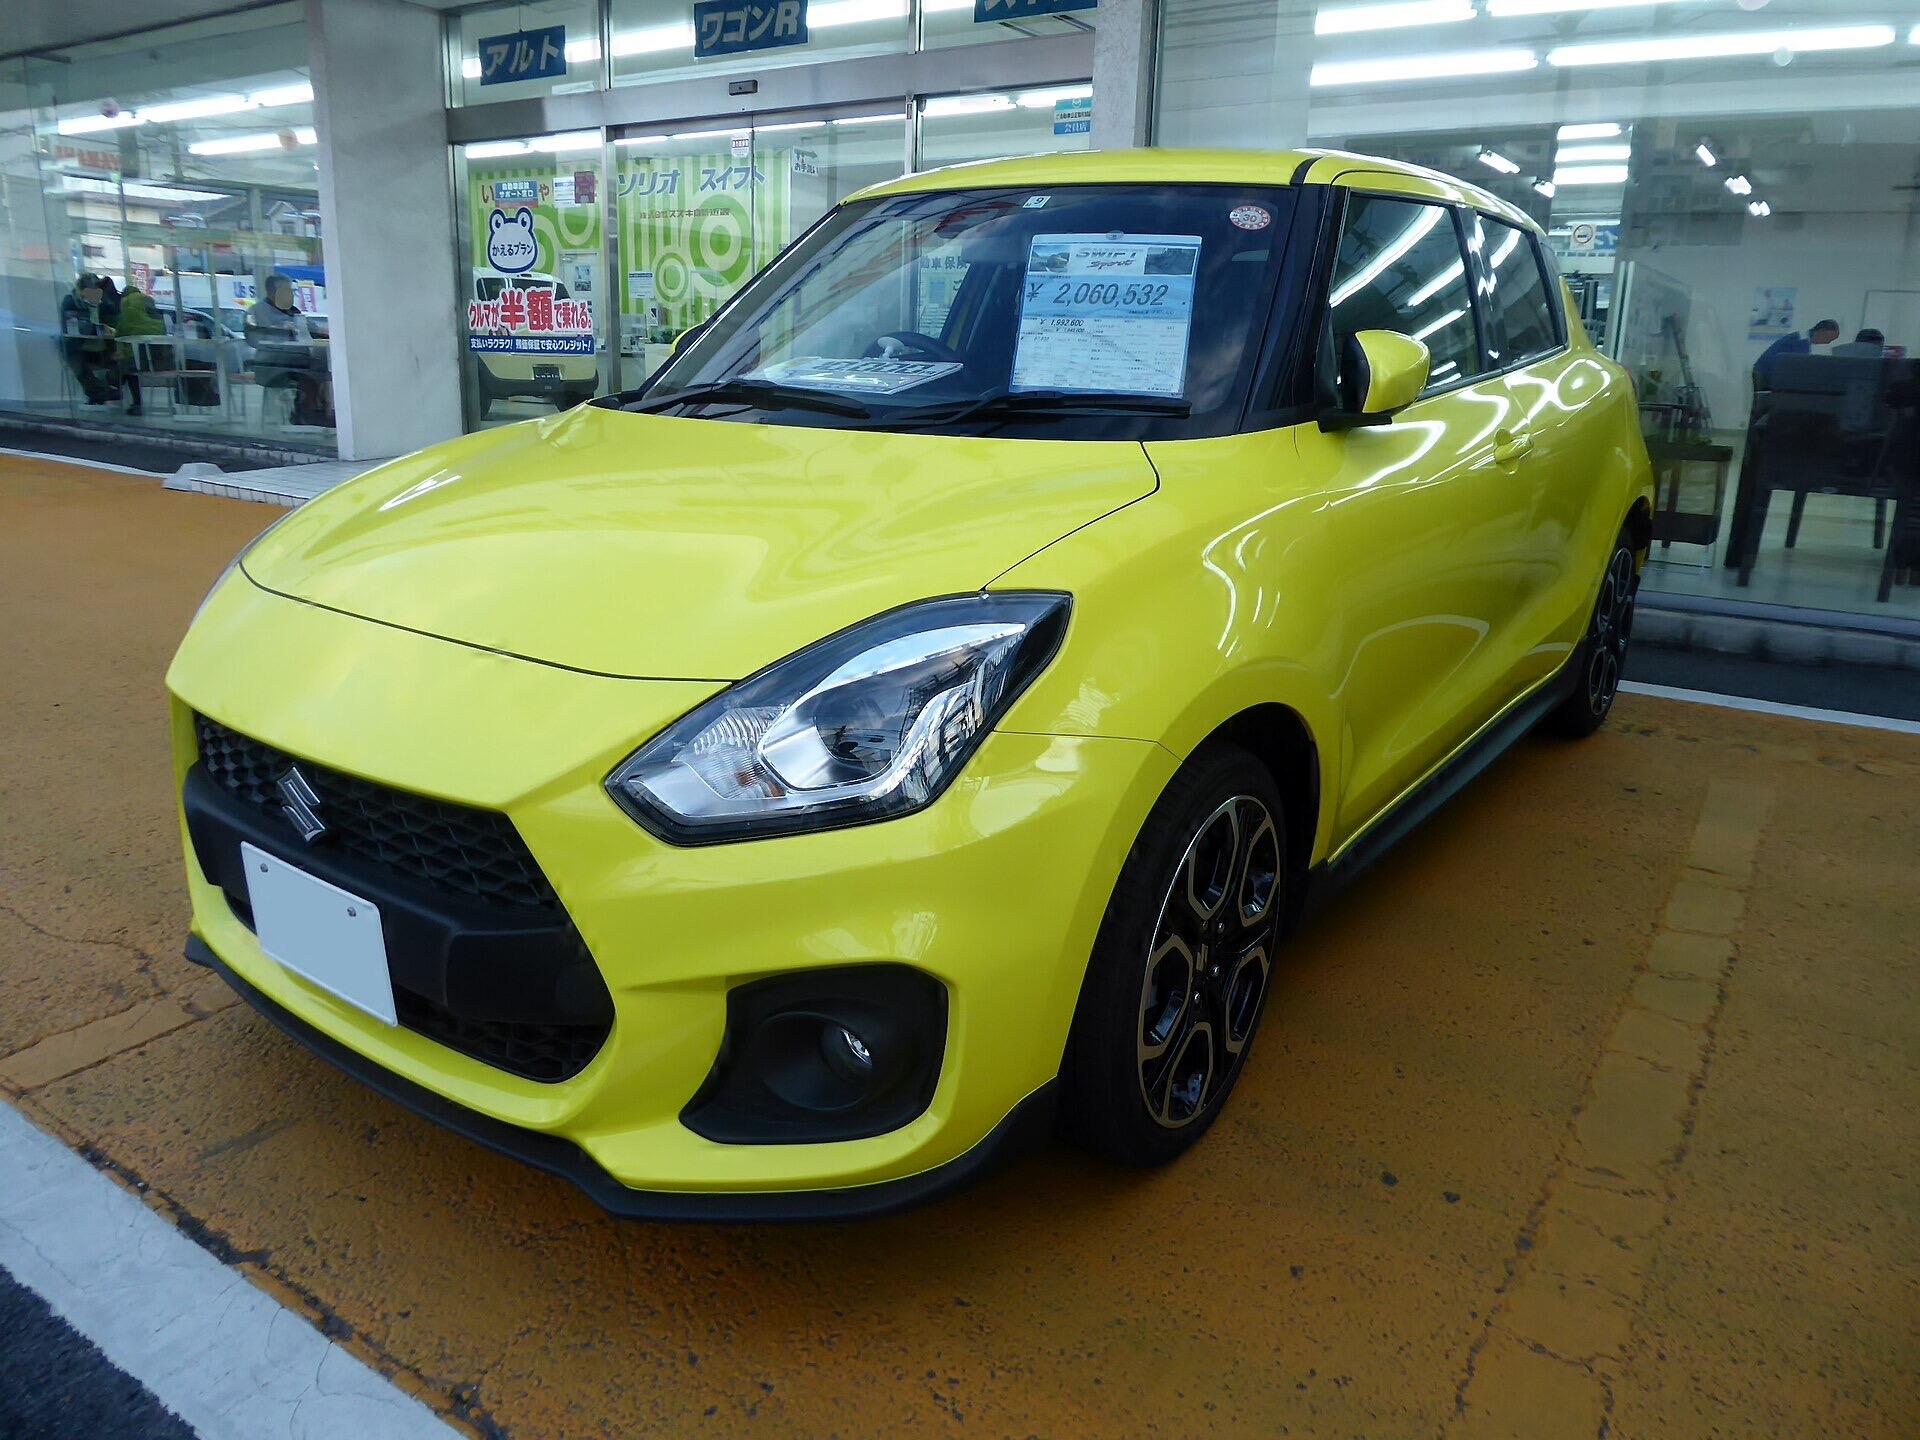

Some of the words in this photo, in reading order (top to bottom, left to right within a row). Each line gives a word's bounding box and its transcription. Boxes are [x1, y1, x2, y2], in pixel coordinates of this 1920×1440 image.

[701, 2, 800, 49] ワゴンR
[485, 35, 560, 76] アルト
[618, 170, 680, 197] ソリオ
[700, 165, 766, 192] スイフト
[492, 242, 534, 257] かえるプラン
[1026, 283, 1044, 302] ¥
[1052, 282, 1169, 307] 2,060,532
